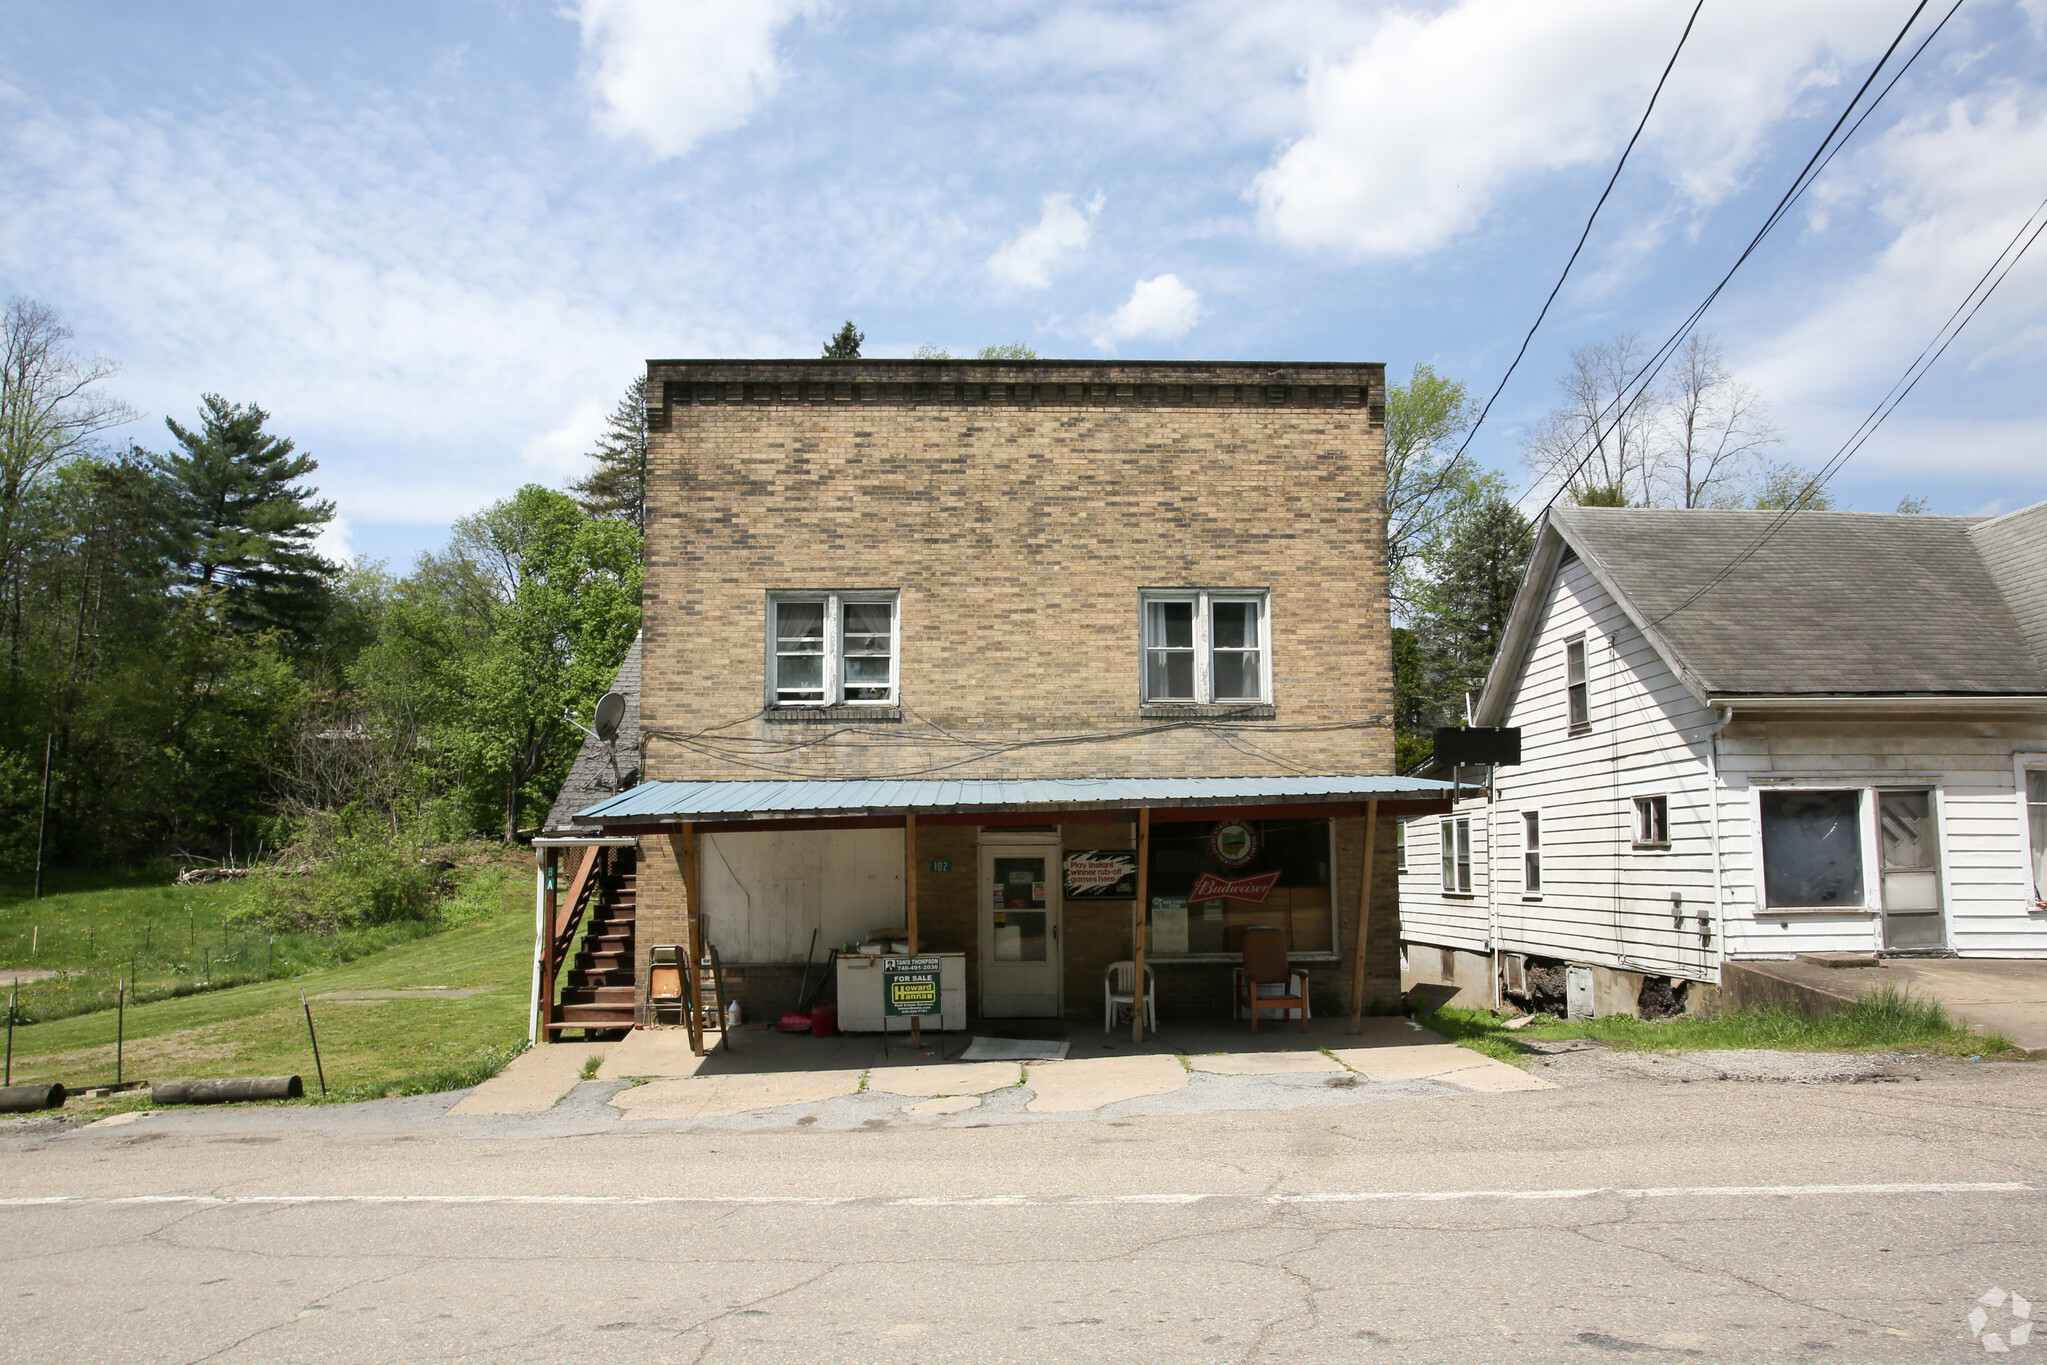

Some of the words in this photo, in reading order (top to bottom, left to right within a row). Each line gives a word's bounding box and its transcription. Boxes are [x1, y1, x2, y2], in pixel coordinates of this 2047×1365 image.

[934, 861, 948, 872] 102
[548, 880, 553, 890] A
[1070, 876, 1098, 884] games
[1195, 880, 1271, 895] Budweiser
